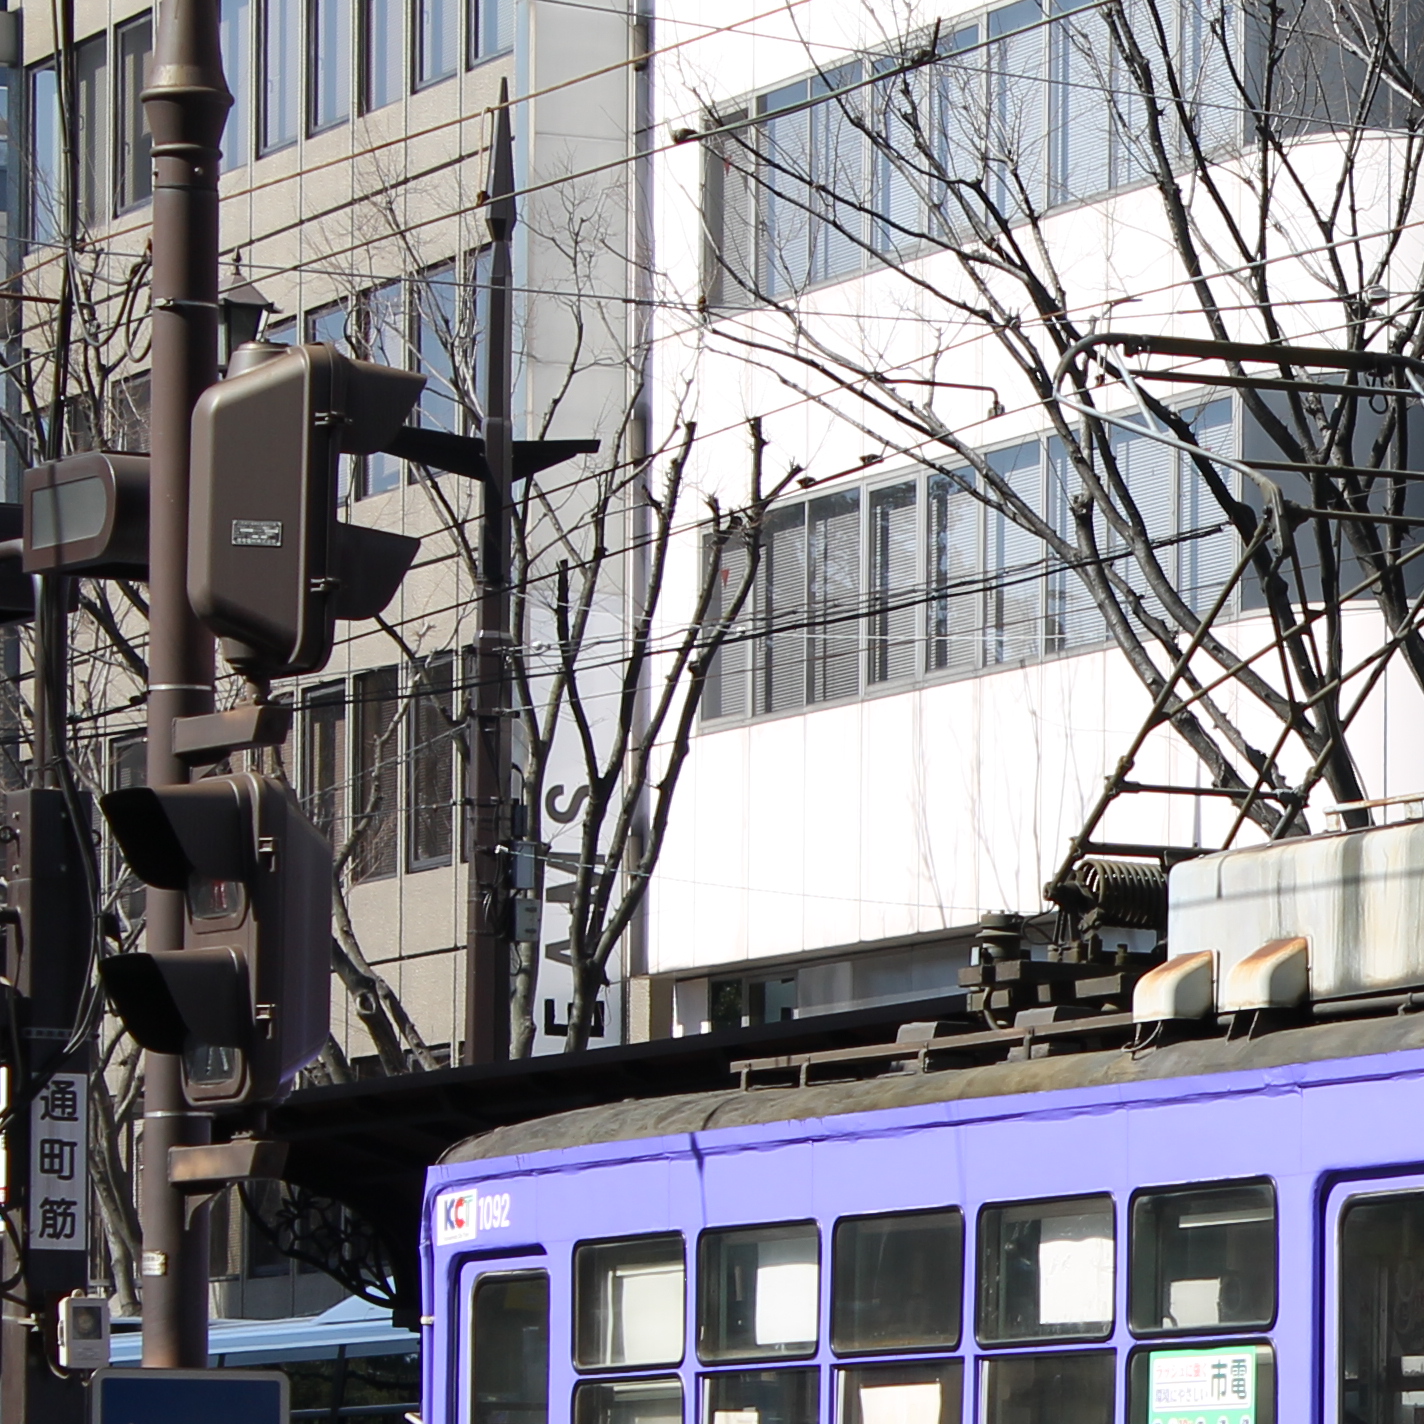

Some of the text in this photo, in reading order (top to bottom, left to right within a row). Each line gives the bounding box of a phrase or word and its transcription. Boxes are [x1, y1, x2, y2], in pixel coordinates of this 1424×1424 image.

[39, 1080, 78, 1241] 通町筋
[444, 1193, 511, 1232] KCT 1092
[1211, 1358, 1247, 1402] 市電
